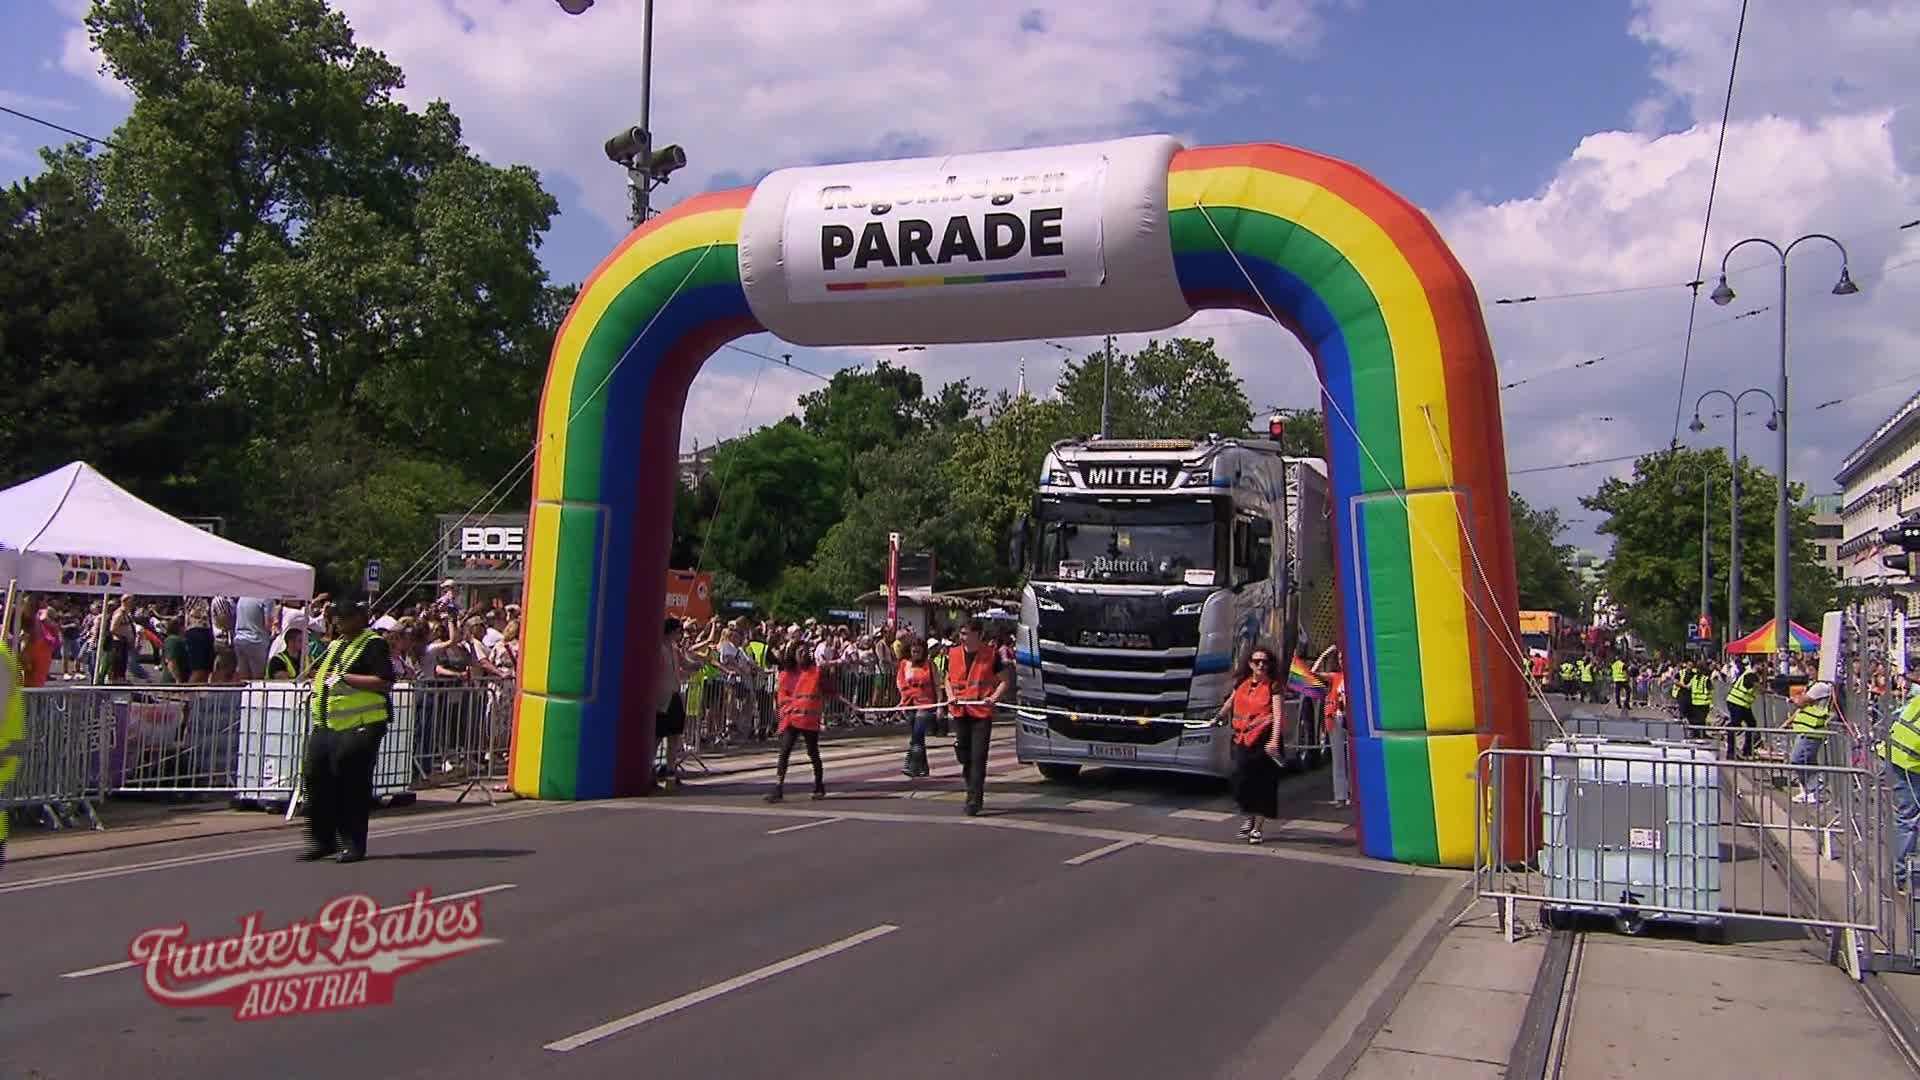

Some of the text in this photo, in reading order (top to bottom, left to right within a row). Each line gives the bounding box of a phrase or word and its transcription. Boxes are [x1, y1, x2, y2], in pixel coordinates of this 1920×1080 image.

[822, 207, 1065, 271] PARADE
[1088, 467, 1168, 485] MITTER
[462, 527, 524, 551] BOE
[56, 553, 131, 571] VIENNA
[1094, 555, 1149, 574] Patricia
[61, 570, 123, 587] PRIDE
